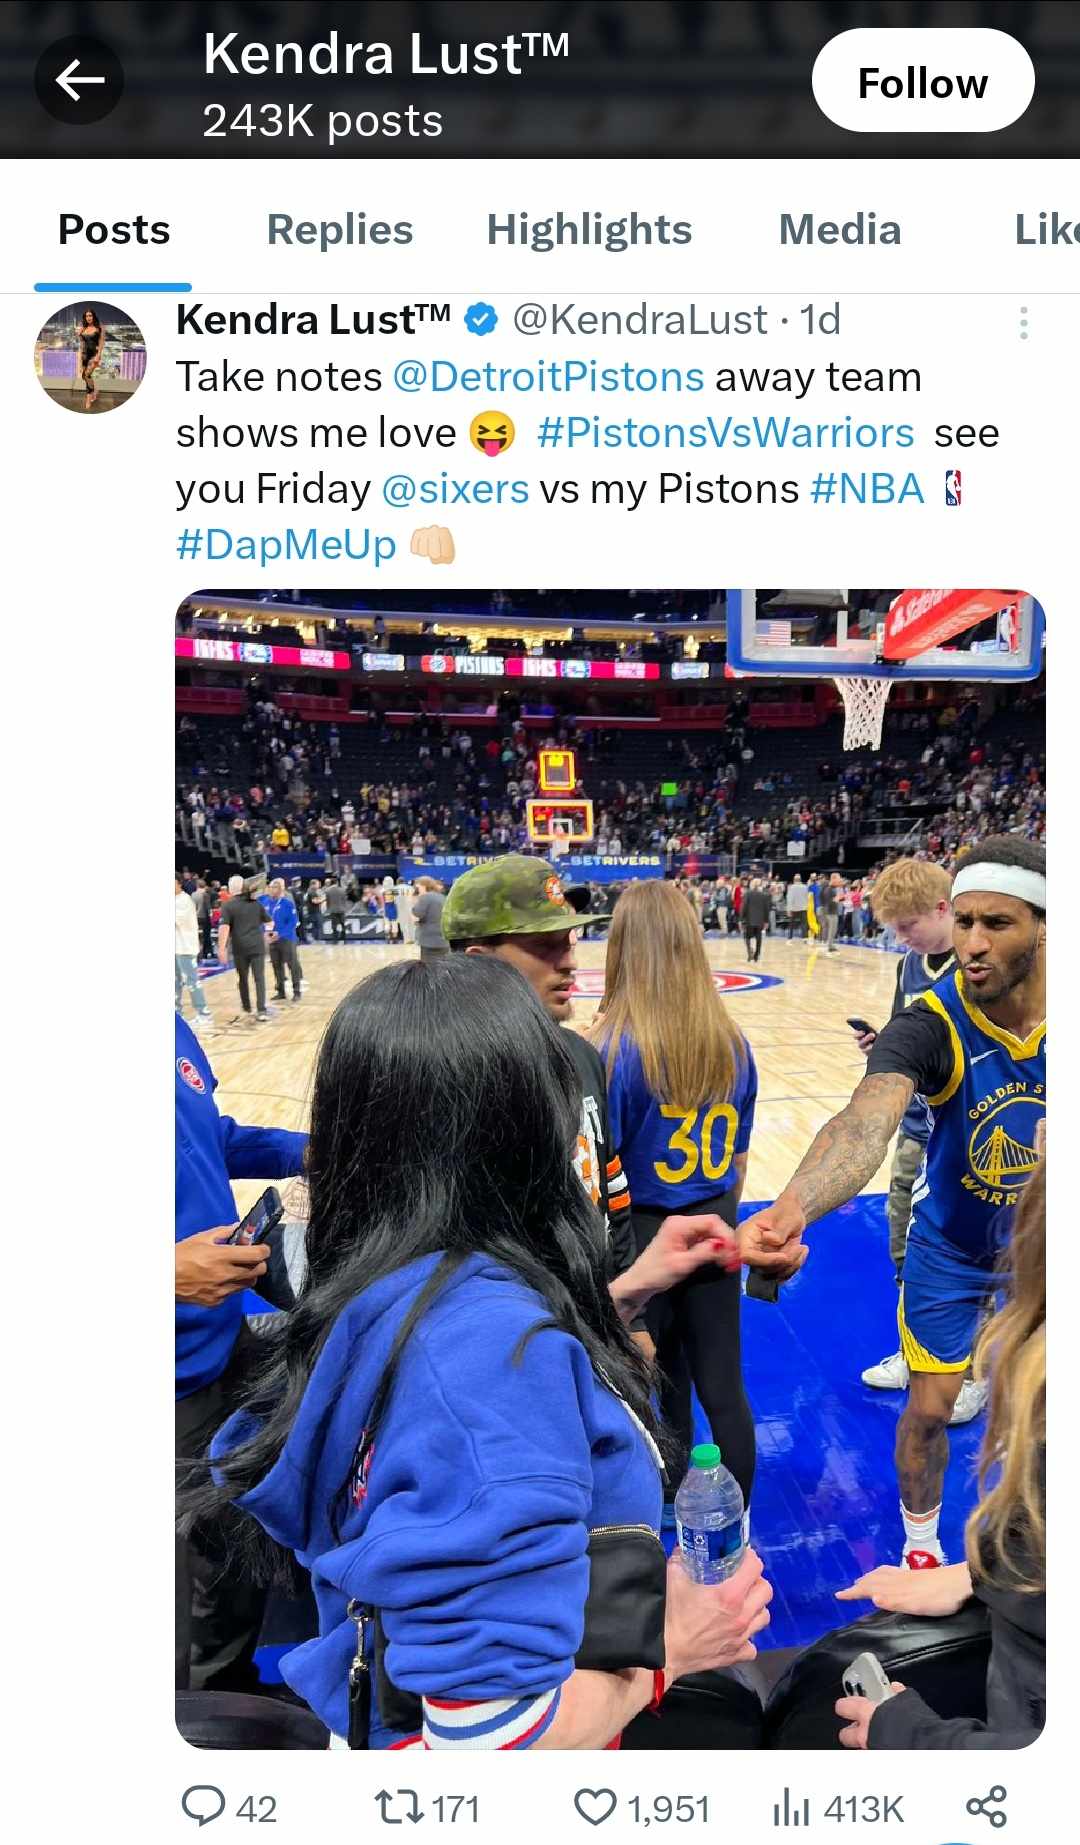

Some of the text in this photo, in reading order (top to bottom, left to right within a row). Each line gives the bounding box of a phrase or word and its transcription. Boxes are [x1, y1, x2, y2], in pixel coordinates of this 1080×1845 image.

[571, 855, 660, 866] BETRIVERS
[969, 1082, 1026, 1119] GOLDEN
[654, 1104, 739, 1184] 30
[961, 1174, 1018, 1206] WARR
